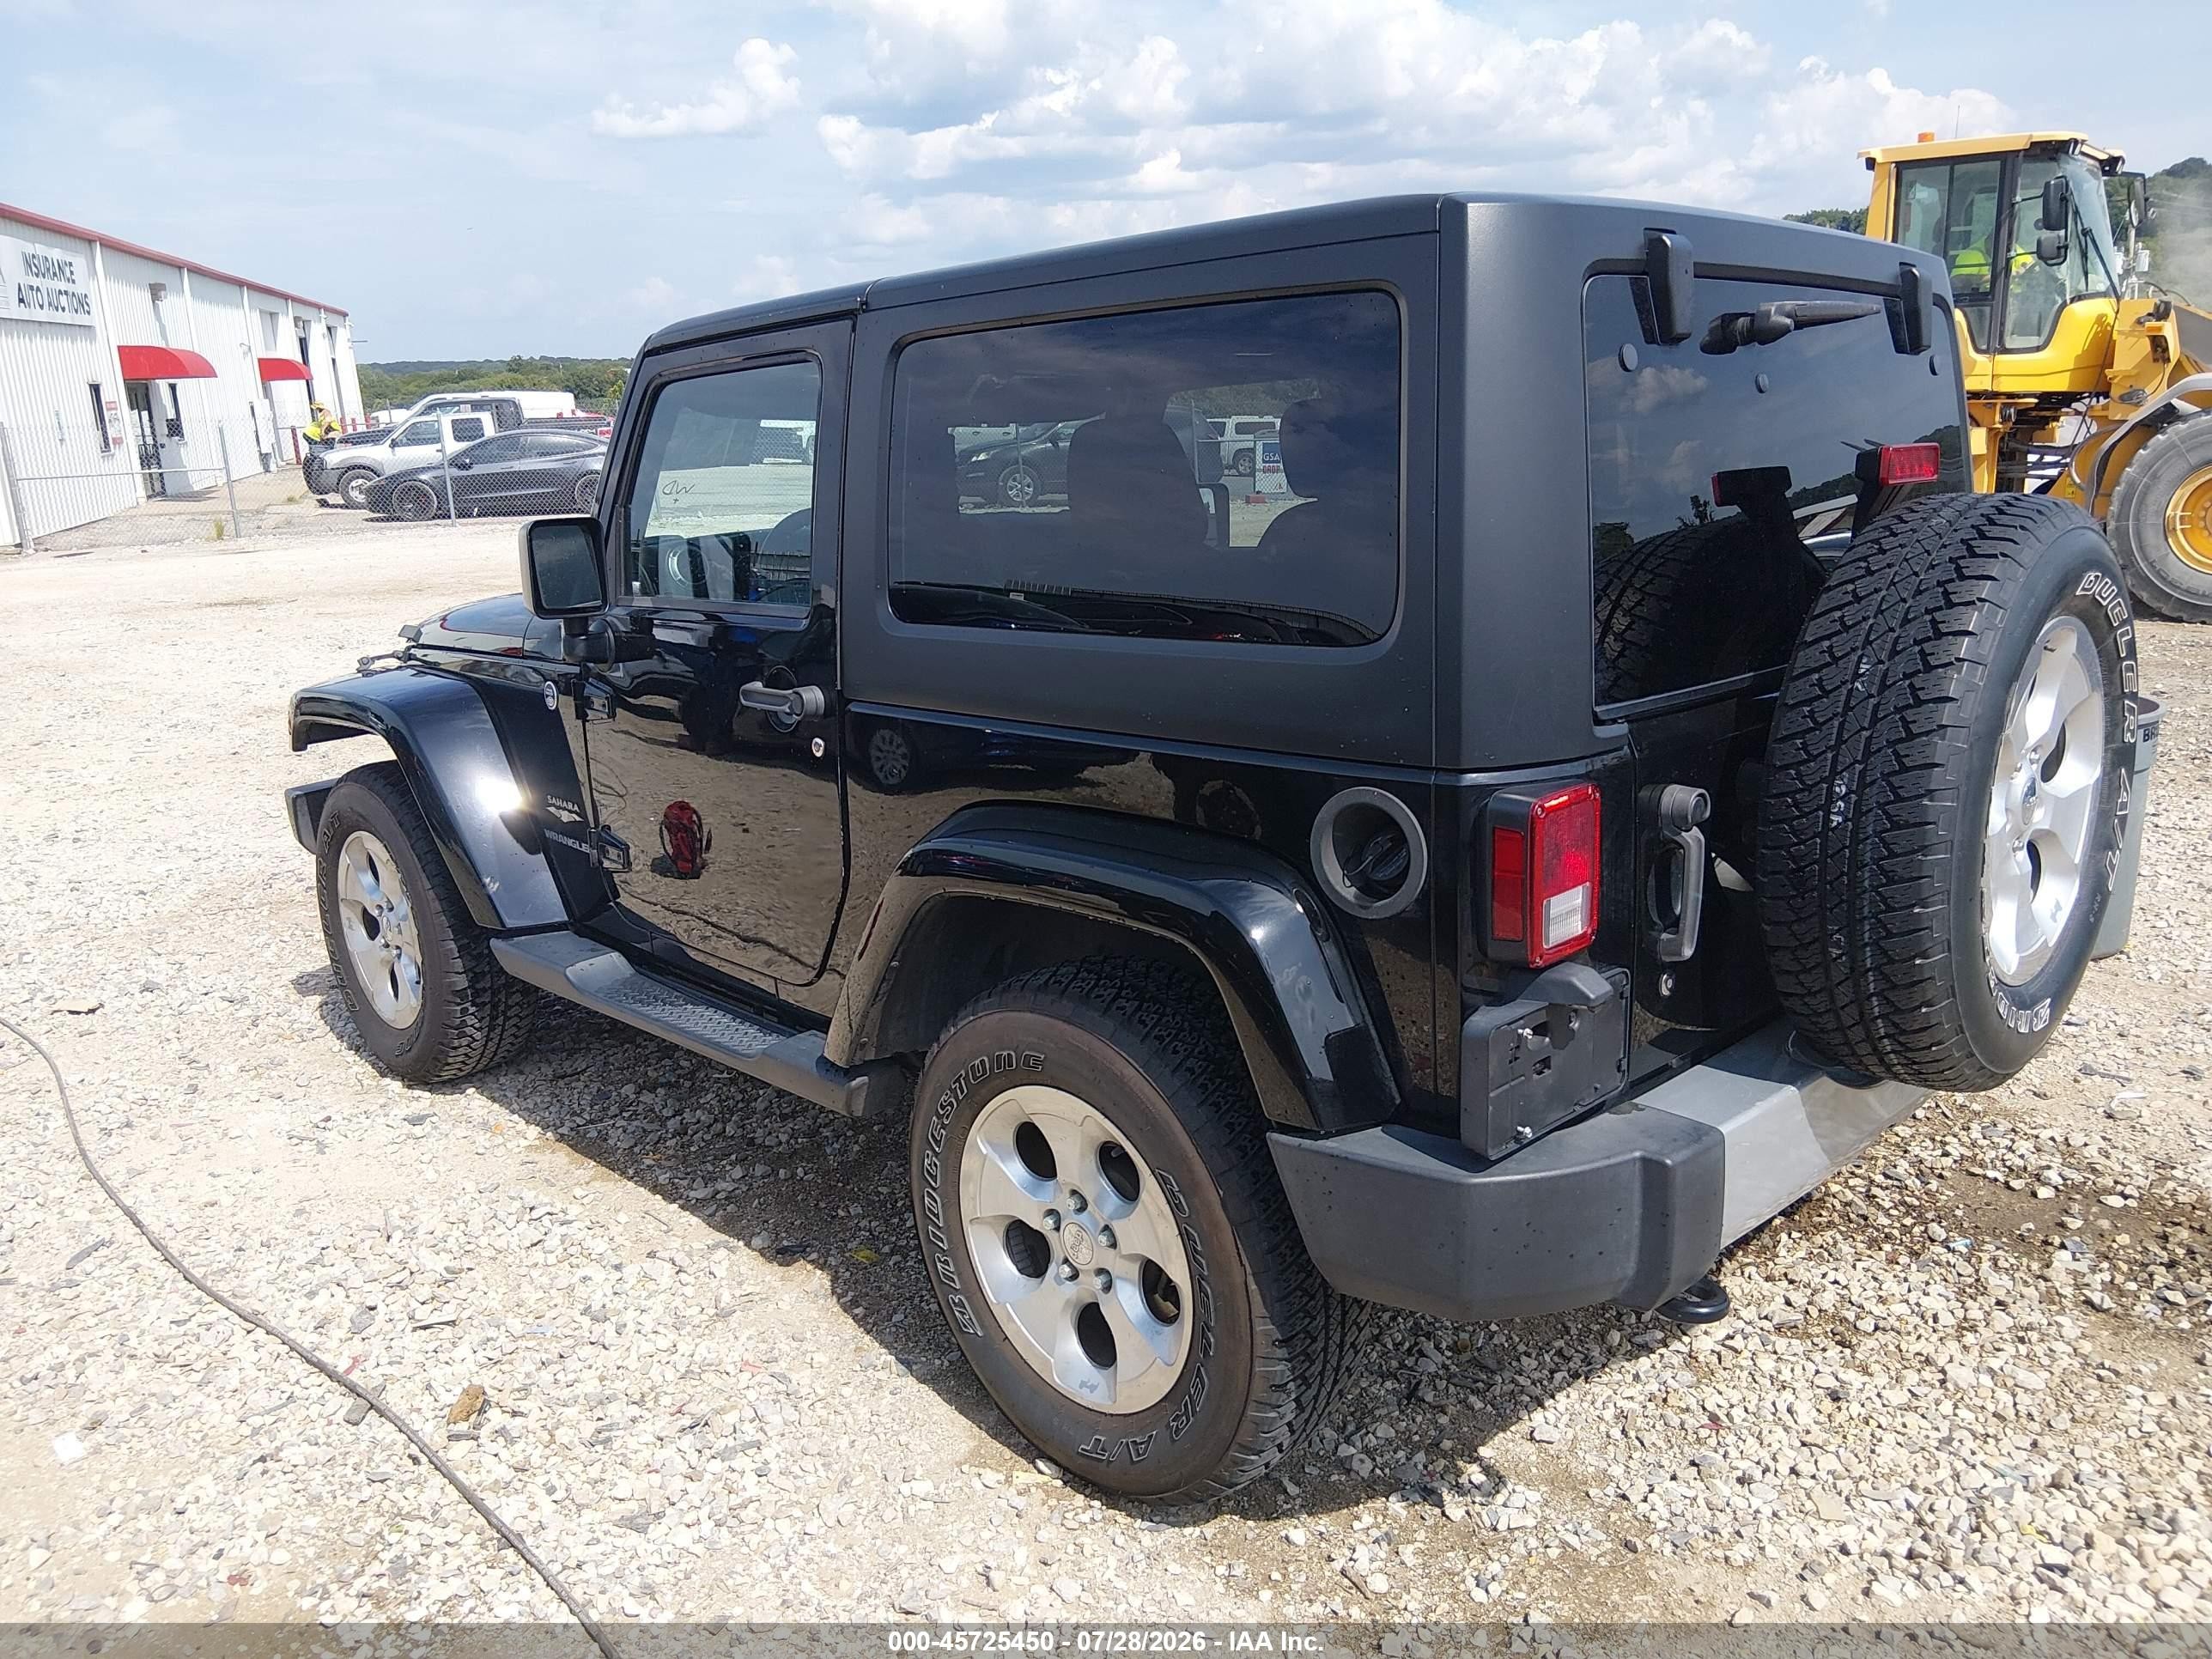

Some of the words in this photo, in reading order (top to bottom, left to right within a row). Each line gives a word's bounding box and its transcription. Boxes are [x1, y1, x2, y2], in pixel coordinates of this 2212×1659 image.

[21, 251, 76, 284] INSURANCE
[17, 282, 44, 310] AUTO
[46, 287, 91, 316] AUCTIONS
[1263, 453, 1280, 461] GSA
[2075, 572, 2137, 744] DUELER
[2106, 768, 2130, 891] A/T
[547, 794, 580, 812] SAHARA
[544, 828, 590, 854] WRANGLE
[923, 1050, 1045, 1337] BRIDGESTONE
[1155, 1167, 1217, 1440] DUELER
[1079, 1430, 1158, 1462] A/T
